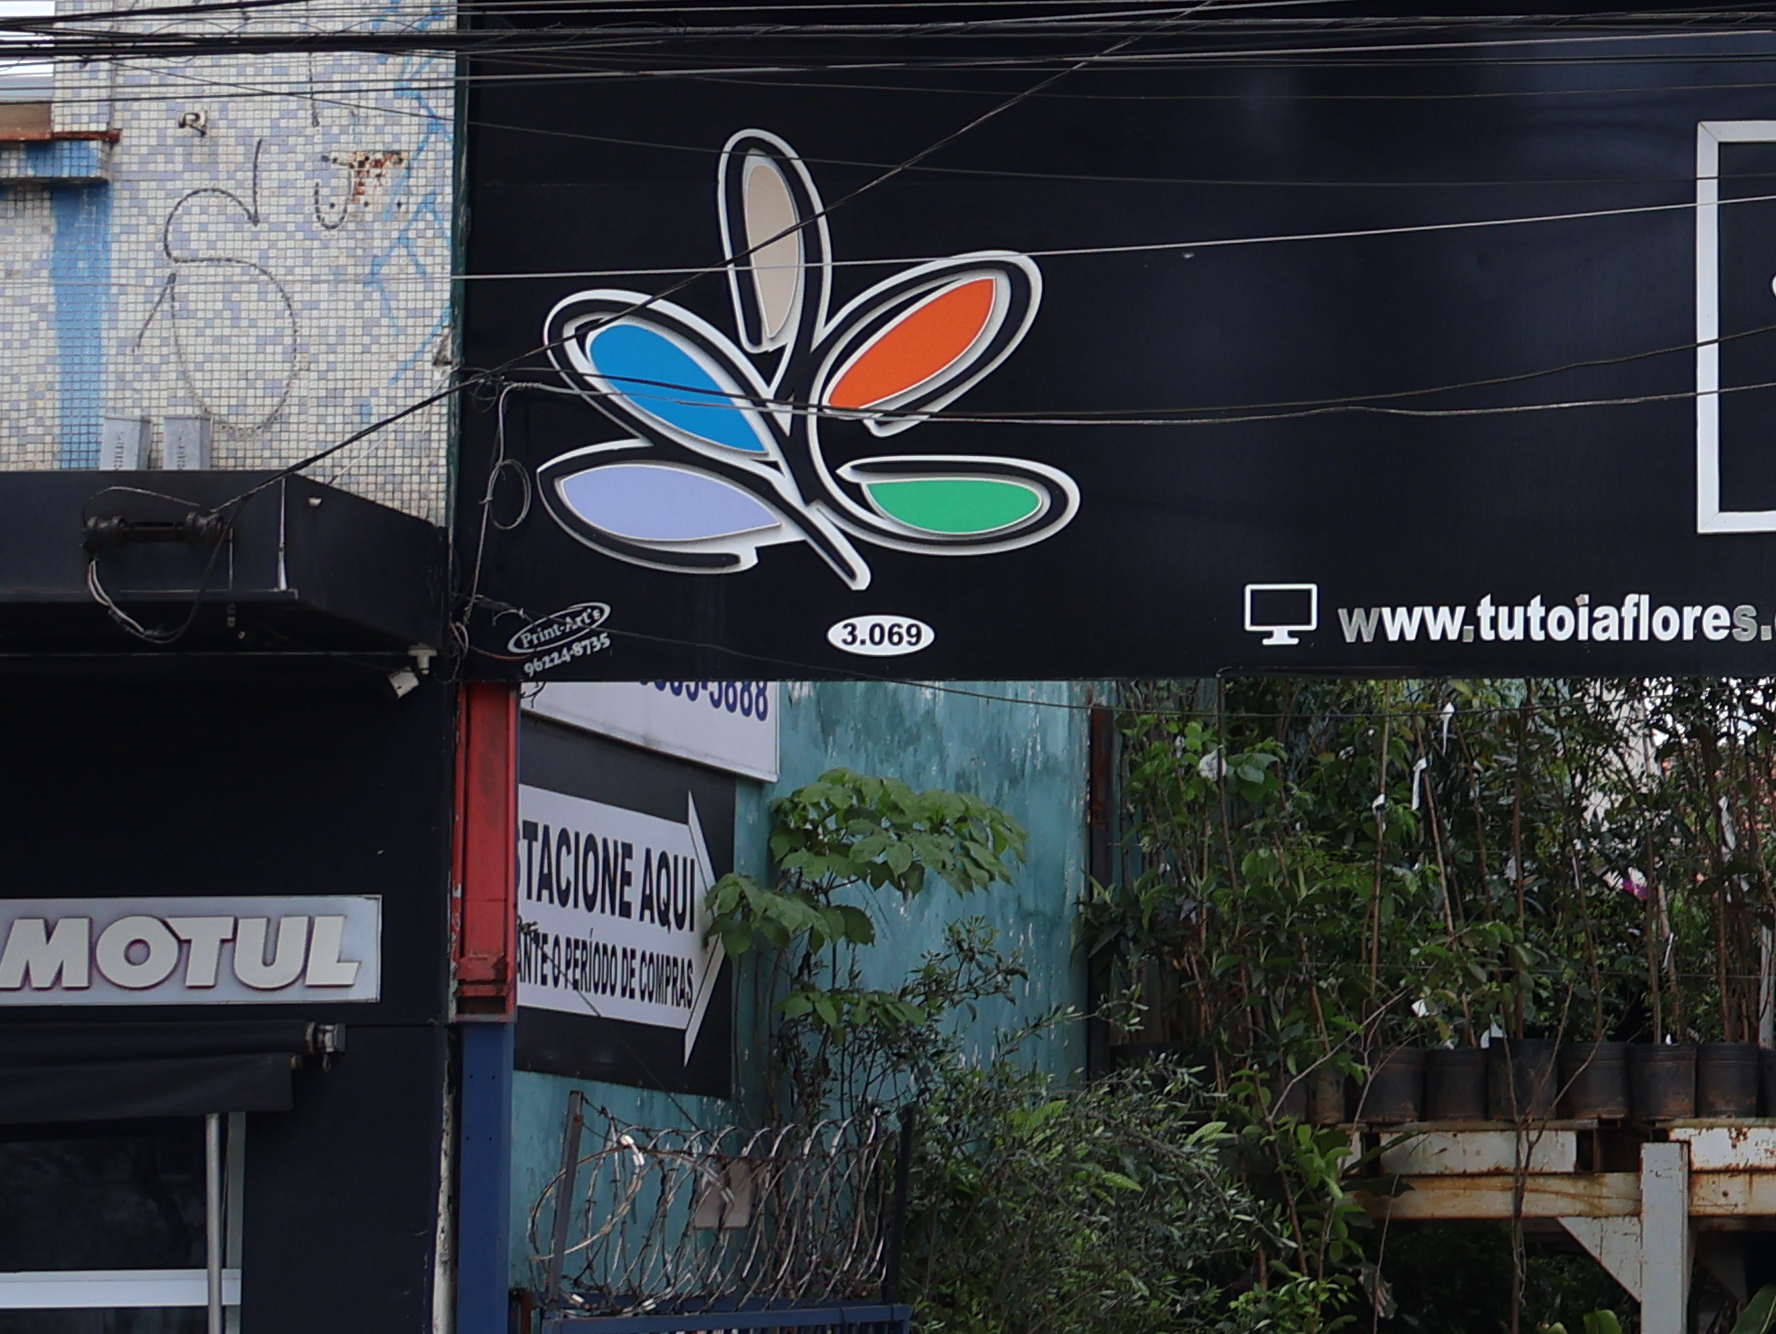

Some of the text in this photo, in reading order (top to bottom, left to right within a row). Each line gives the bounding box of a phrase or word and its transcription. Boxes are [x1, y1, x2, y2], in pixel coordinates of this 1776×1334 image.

[523, 632, 612, 679] 96224-8735
[840, 621, 924, 649] 3.069
[640, 680, 769, 722] -5888
[517, 819, 696, 935] TACIONE AQUI
[0, 914, 362, 991] MOTUL
[564, 926, 618, 999] PERÍODO
[620, 946, 637, 999] DE
[639, 948, 695, 1010] COMPRAS
